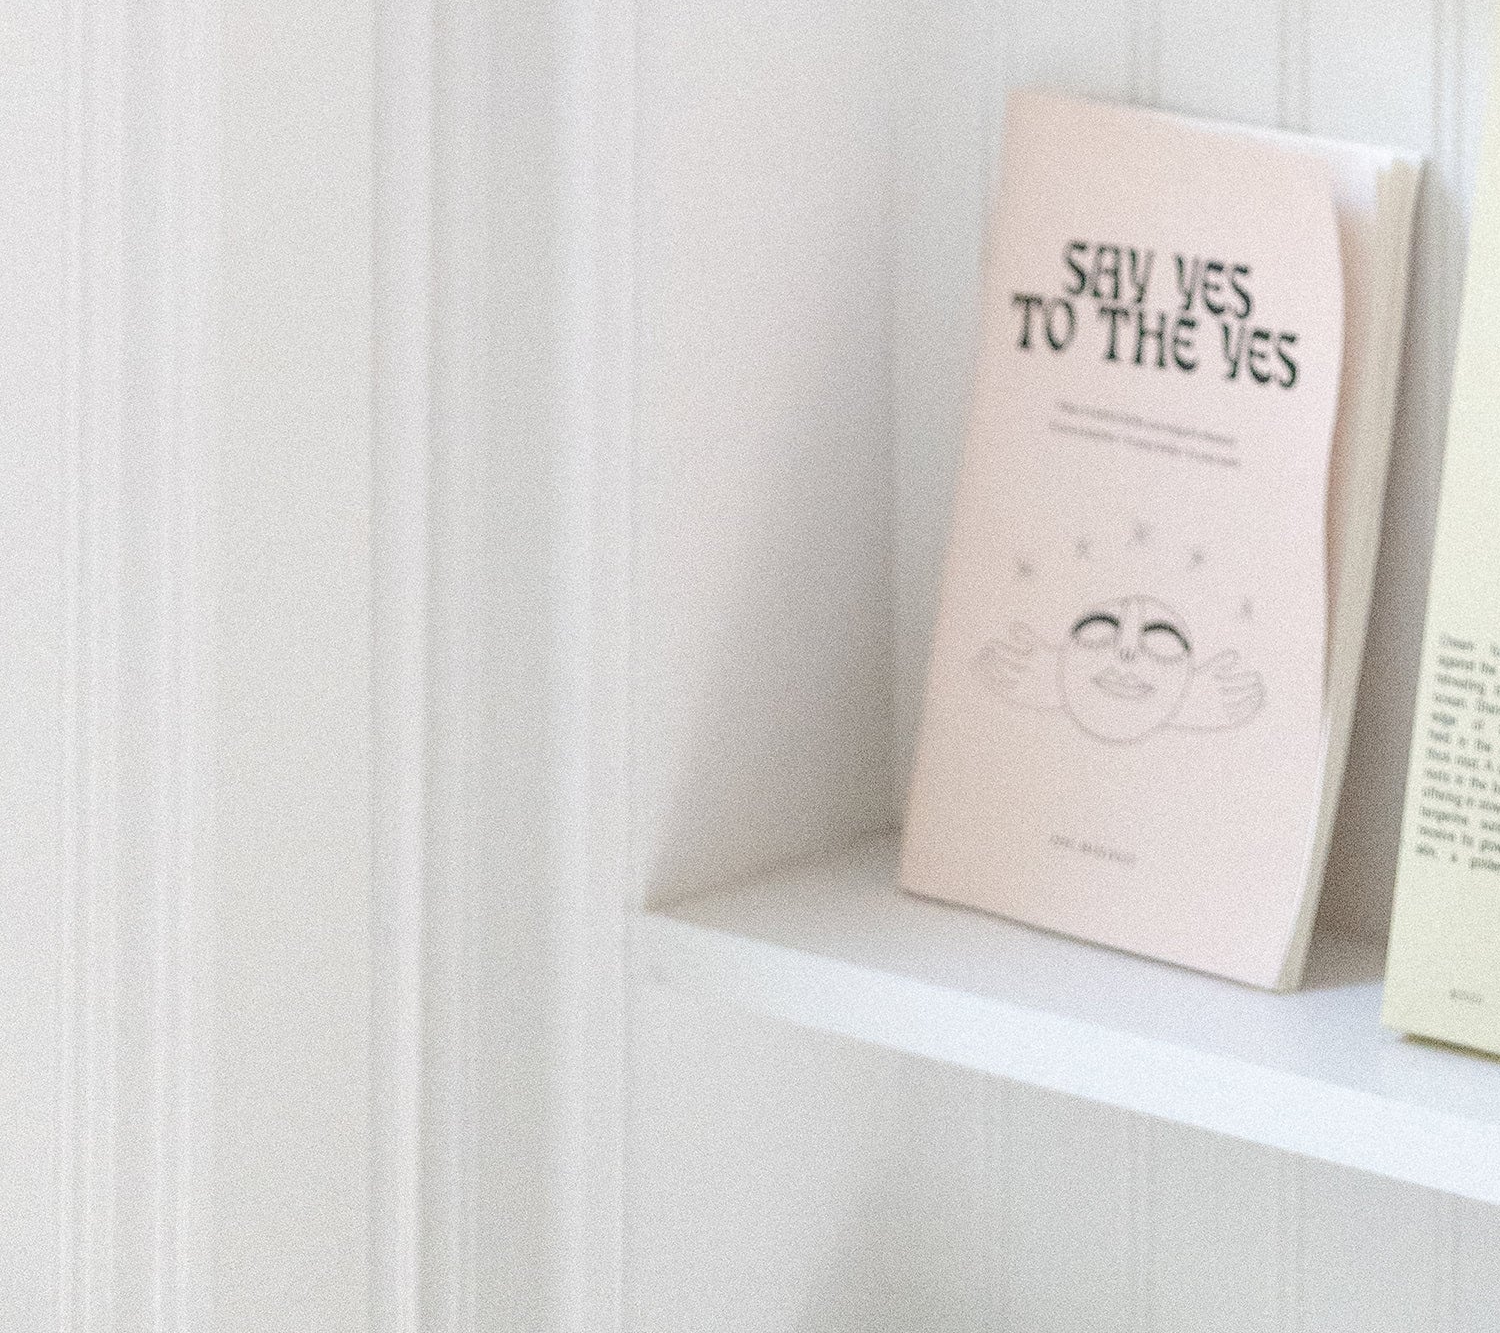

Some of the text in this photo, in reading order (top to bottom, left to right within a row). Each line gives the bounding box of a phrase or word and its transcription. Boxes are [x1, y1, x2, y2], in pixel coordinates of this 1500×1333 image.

[1063, 239, 1253, 320] SAY YES
[1011, 291, 1298, 389] TO THE YES
